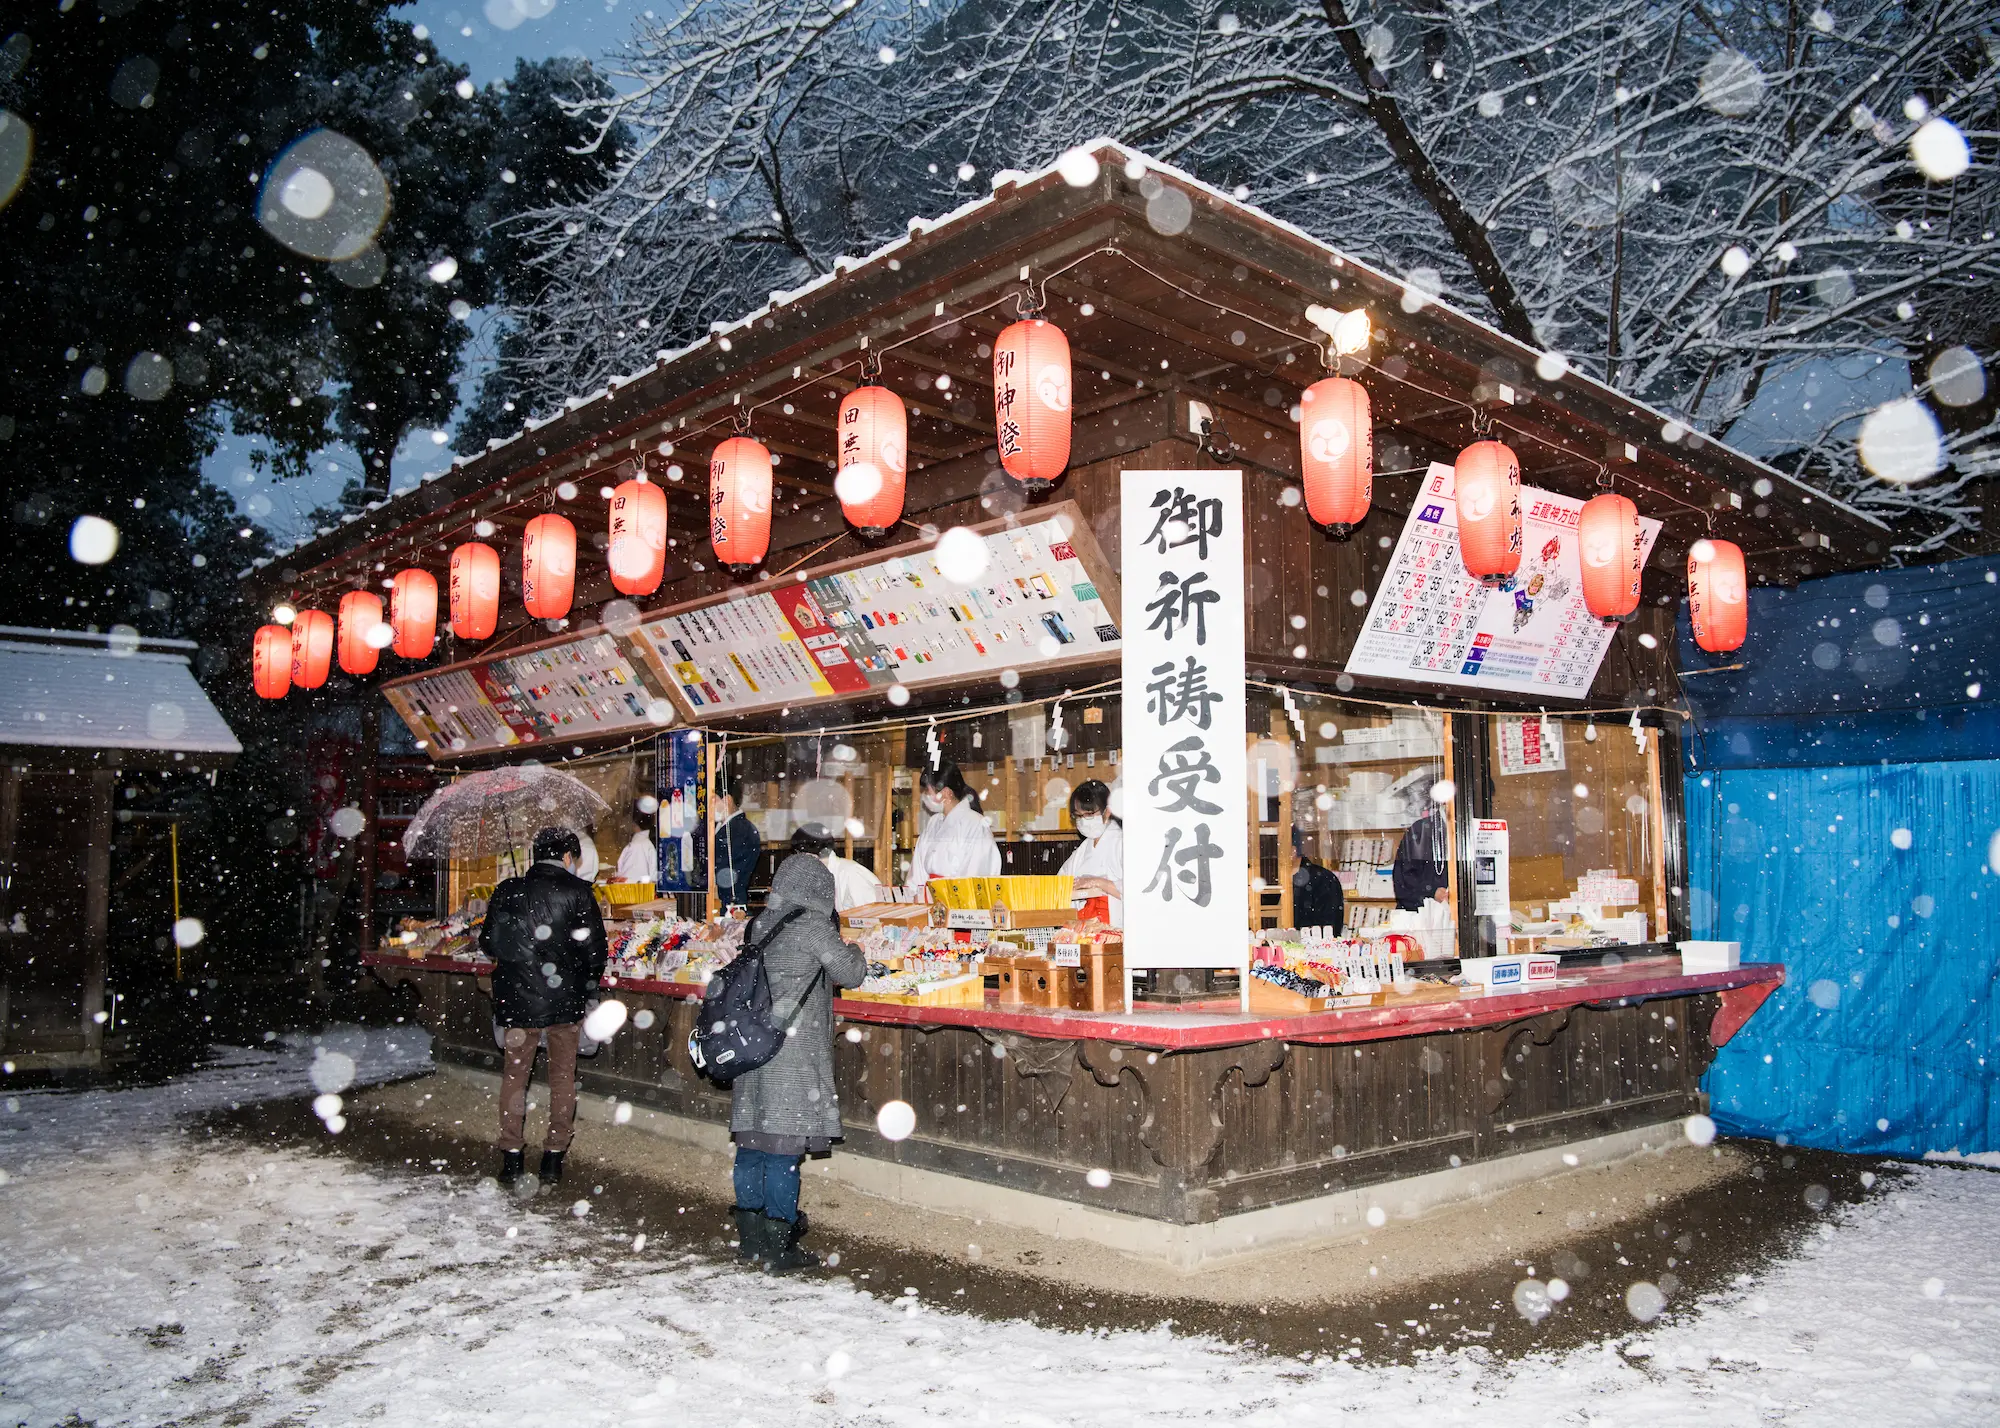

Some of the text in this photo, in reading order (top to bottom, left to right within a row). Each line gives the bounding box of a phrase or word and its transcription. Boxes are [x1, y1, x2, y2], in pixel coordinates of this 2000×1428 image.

[1424, 508, 1441, 520] 男性
[1529, 500, 1580, 526] 五龍神方位
[1139, 486, 1225, 908] 御祈祷受付
[1494, 967, 1519, 980] 消毒済み
[1530, 965, 1554, 976] 使用済み
